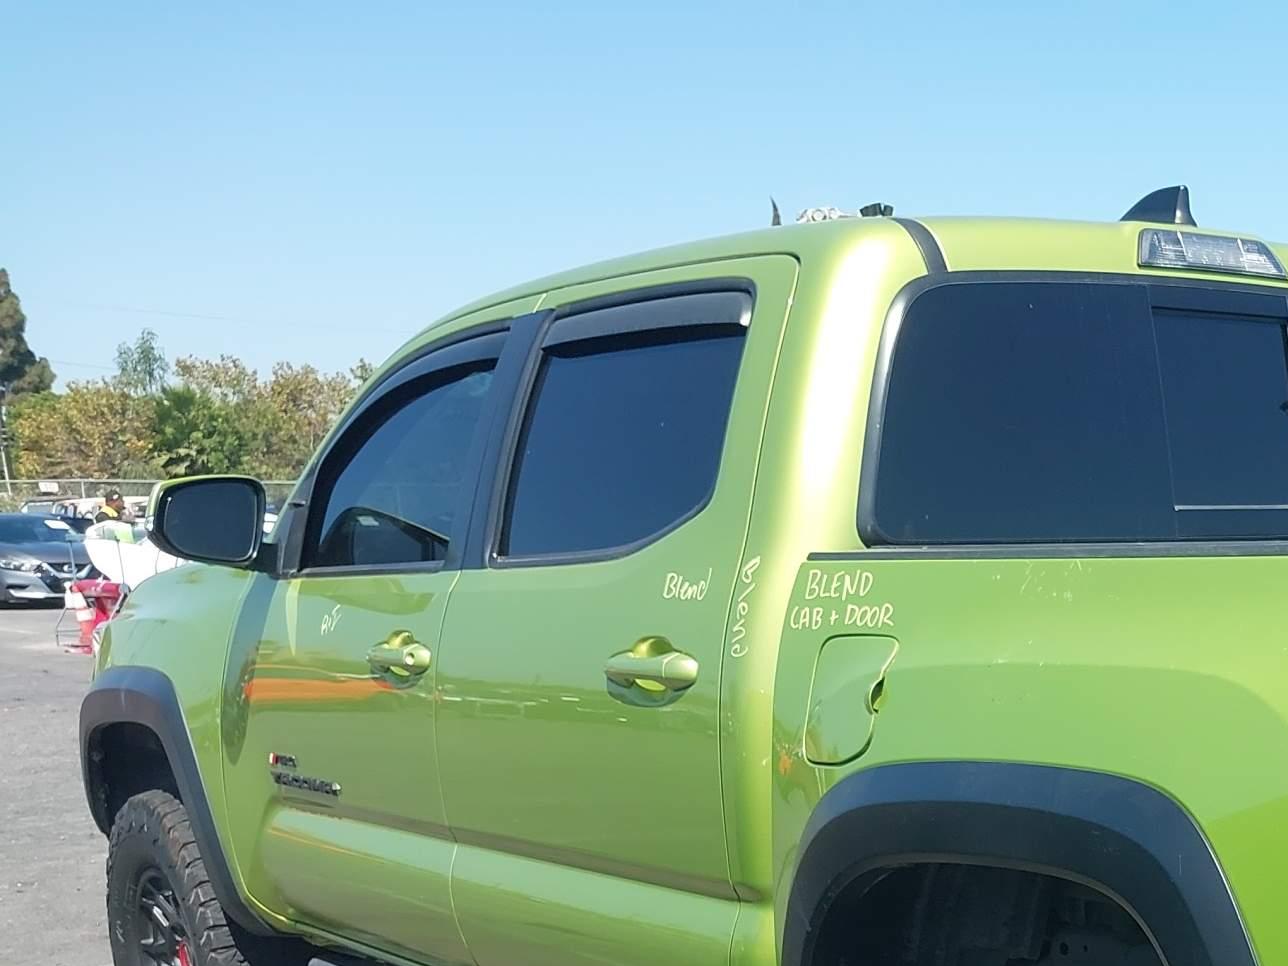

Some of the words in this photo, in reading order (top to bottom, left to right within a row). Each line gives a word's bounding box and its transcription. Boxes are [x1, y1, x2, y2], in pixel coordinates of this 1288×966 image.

[662, 566, 713, 601] Blend
[805, 569, 873, 600] BLEND
[789, 605, 823, 631] CAB
[829, 609, 839, 628] +
[844, 602, 895, 629] DOOR
